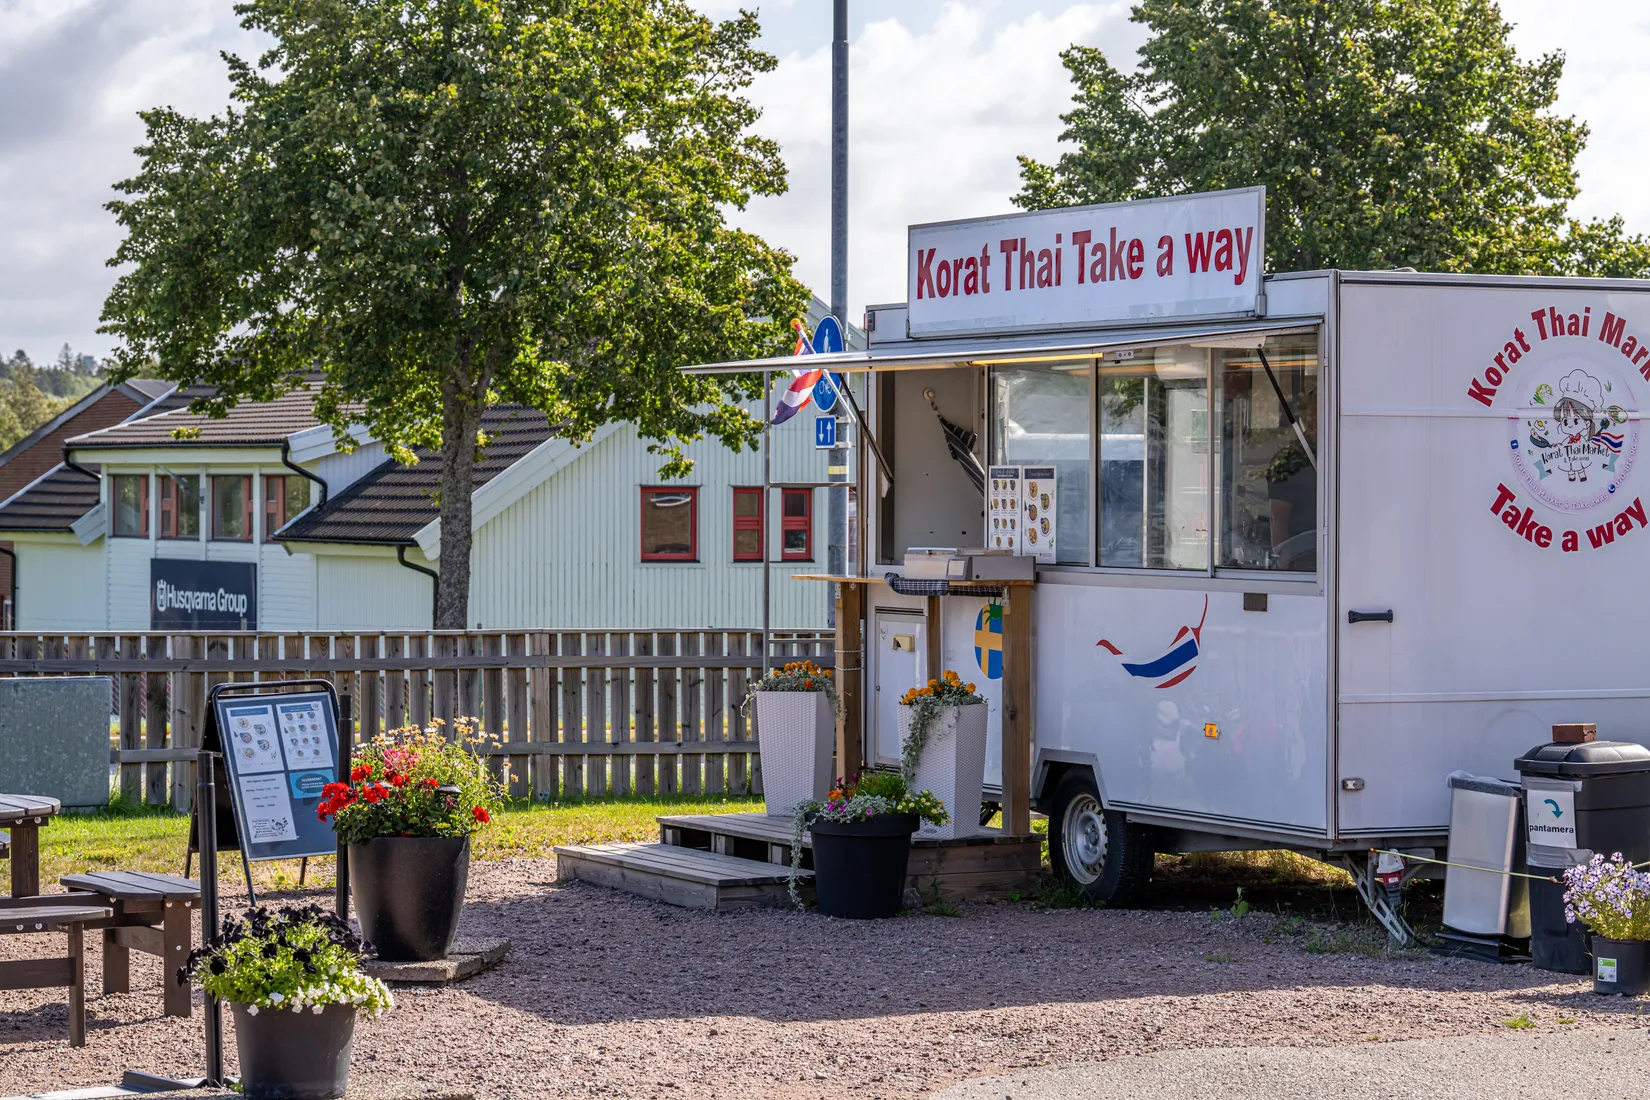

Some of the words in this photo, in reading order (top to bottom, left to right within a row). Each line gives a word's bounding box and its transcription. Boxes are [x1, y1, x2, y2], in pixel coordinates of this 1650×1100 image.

[917, 242, 990, 300] Korat
[1000, 233, 1062, 292] Thai
[1072, 226, 1145, 284] Take
[1156, 235, 1173, 278] a
[1185, 226, 1254, 286] way
[1467, 327, 1531, 407] Korat
[1531, 306, 1591, 341] Thai
[1542, 447, 1564, 464] Korat
[1564, 444, 1581, 457] Thai
[1582, 443, 1610, 457] Market
[1538, 488, 1563, 507] Market
[1490, 482, 1552, 548] Take
[1562, 530, 1579, 552] a
[1585, 497, 1648, 549] way
[167, 584, 216, 614] Husqvarna
[217, 588, 248, 617] Group
[1529, 824, 1574, 834] pantamera
